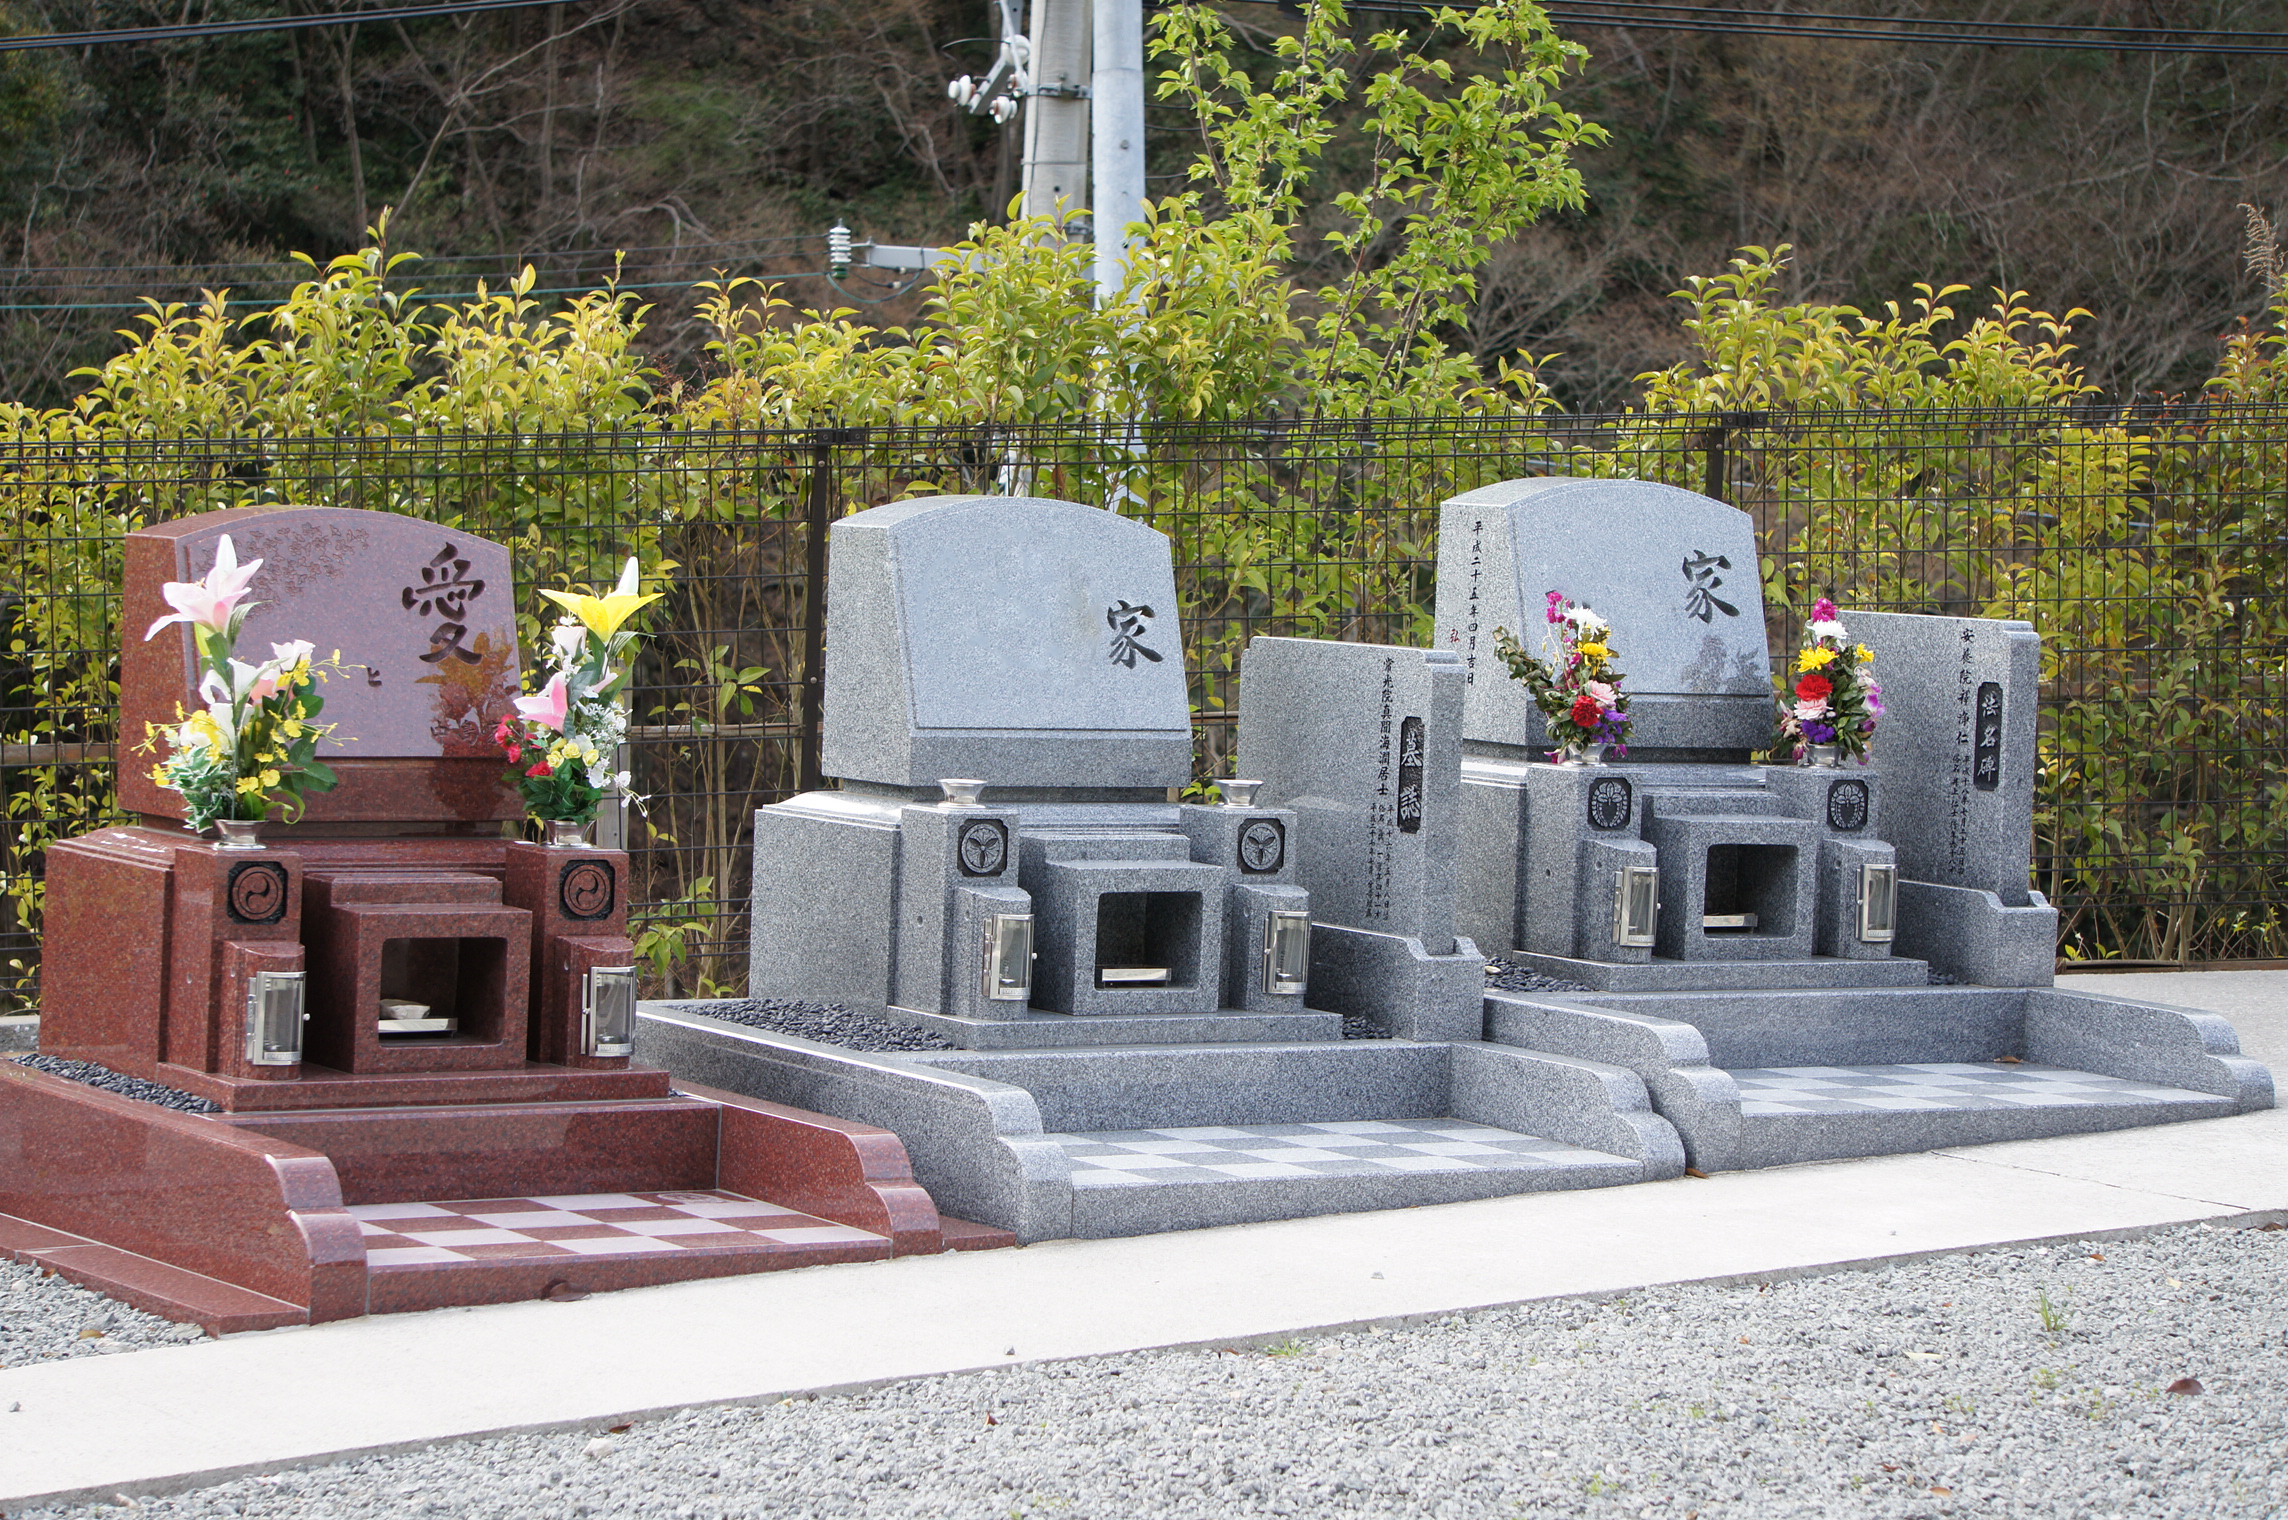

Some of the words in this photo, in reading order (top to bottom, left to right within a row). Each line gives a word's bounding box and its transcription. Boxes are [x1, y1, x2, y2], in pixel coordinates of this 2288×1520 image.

[402, 541, 486, 665] 愛
[1467, 521, 1483, 686] 平成二十五年四月吉日
[1682, 550, 1741, 624] 家
[367, 667, 382, 687] と
[1107, 600, 1164, 670] 家
[1400, 728, 1423, 820] 墓誌
[1978, 691, 1999, 782] 法名碑
